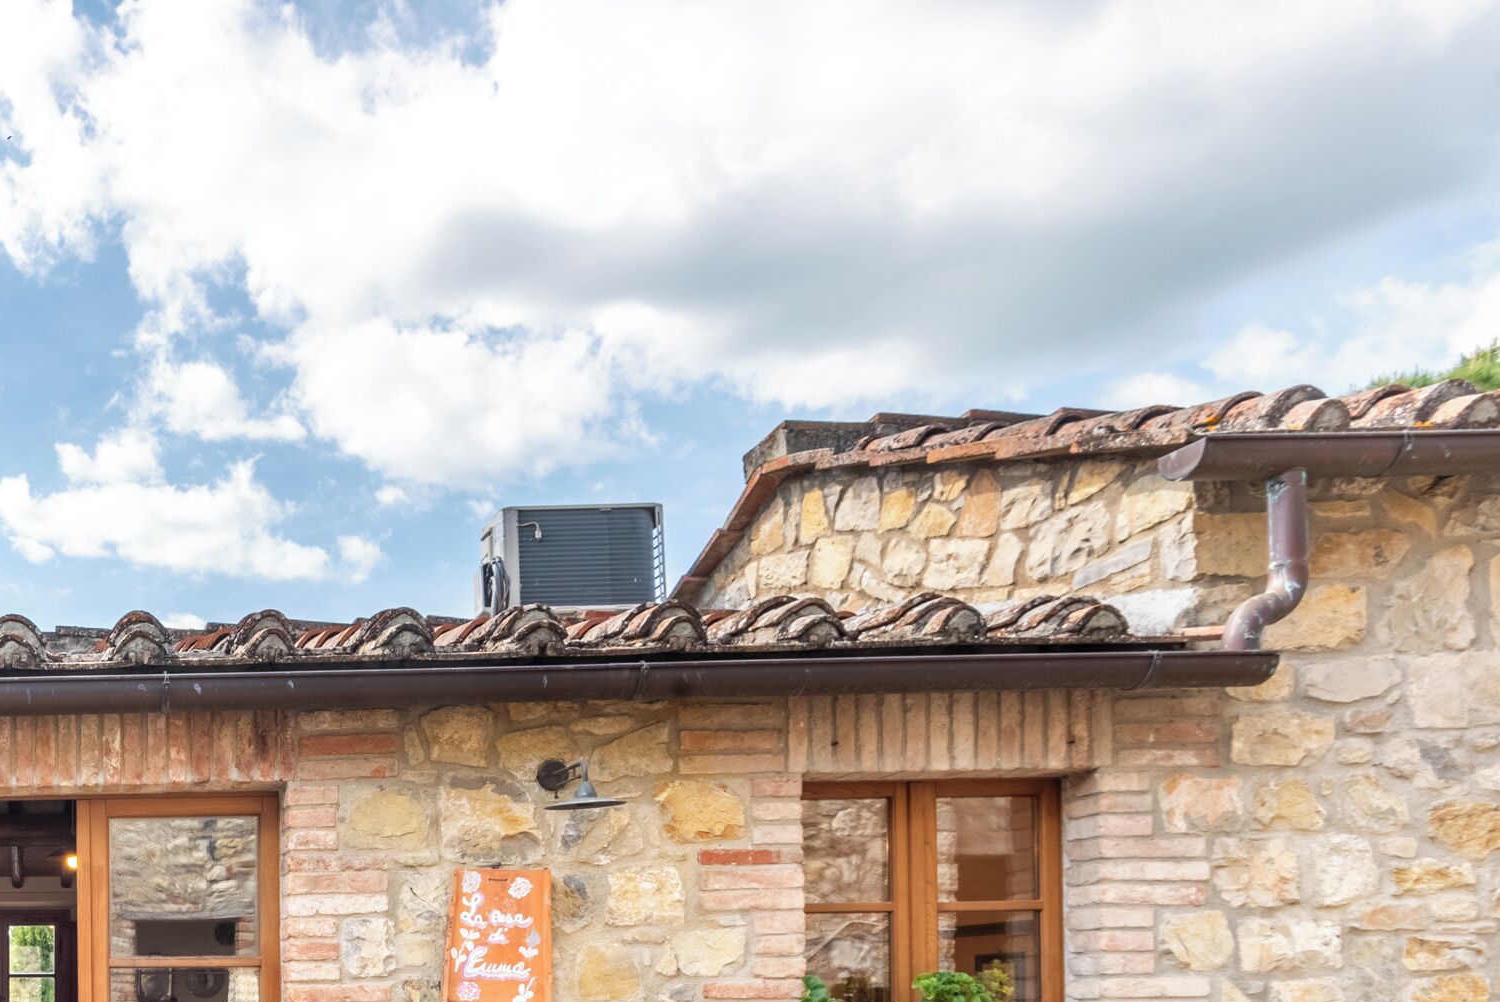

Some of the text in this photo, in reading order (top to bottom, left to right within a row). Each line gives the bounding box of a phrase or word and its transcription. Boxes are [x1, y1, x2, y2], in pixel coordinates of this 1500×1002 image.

[460, 892, 487, 929] La
[488, 927, 510, 944] di
[463, 946, 531, 980] Emma
